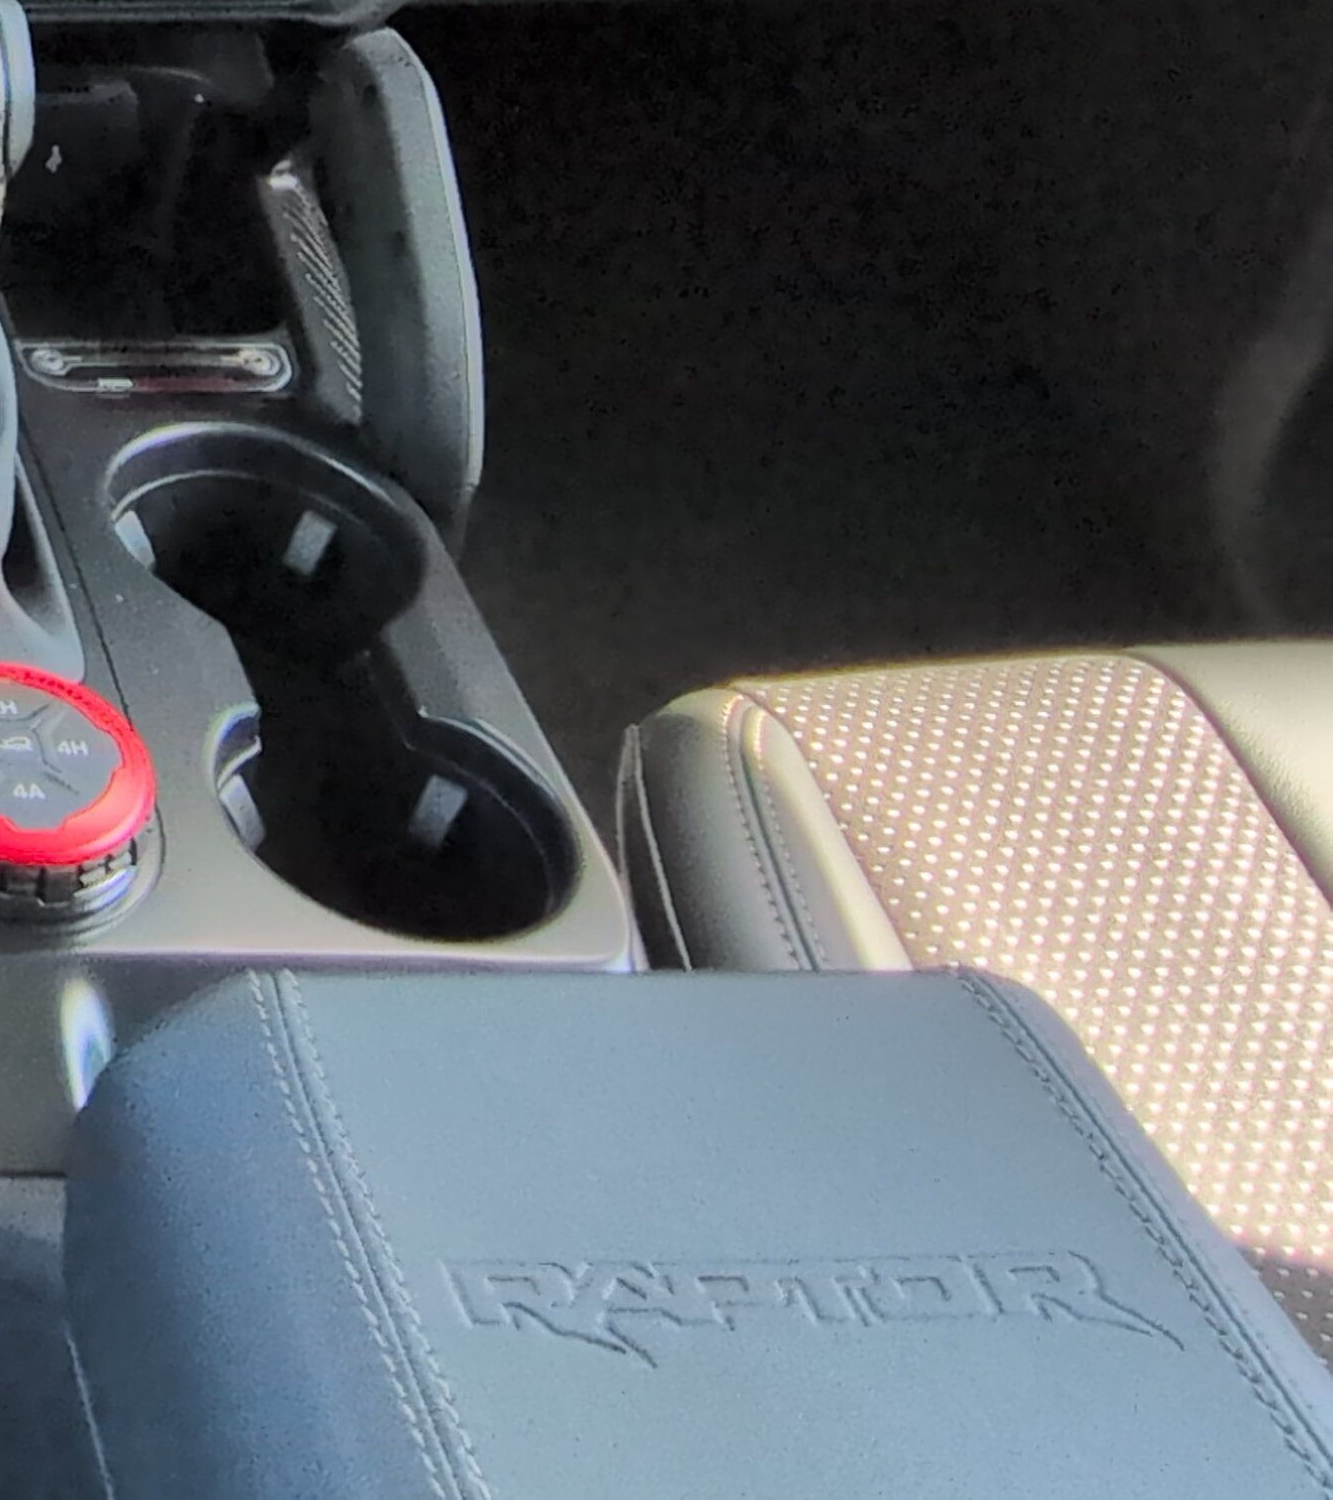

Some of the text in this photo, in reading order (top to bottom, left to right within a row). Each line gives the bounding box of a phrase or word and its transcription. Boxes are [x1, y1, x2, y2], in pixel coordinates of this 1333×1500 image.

[57, 739, 89, 756] 4H
[12, 783, 46, 800] 4A
[437, 1250, 1186, 1368] RAPTOR
